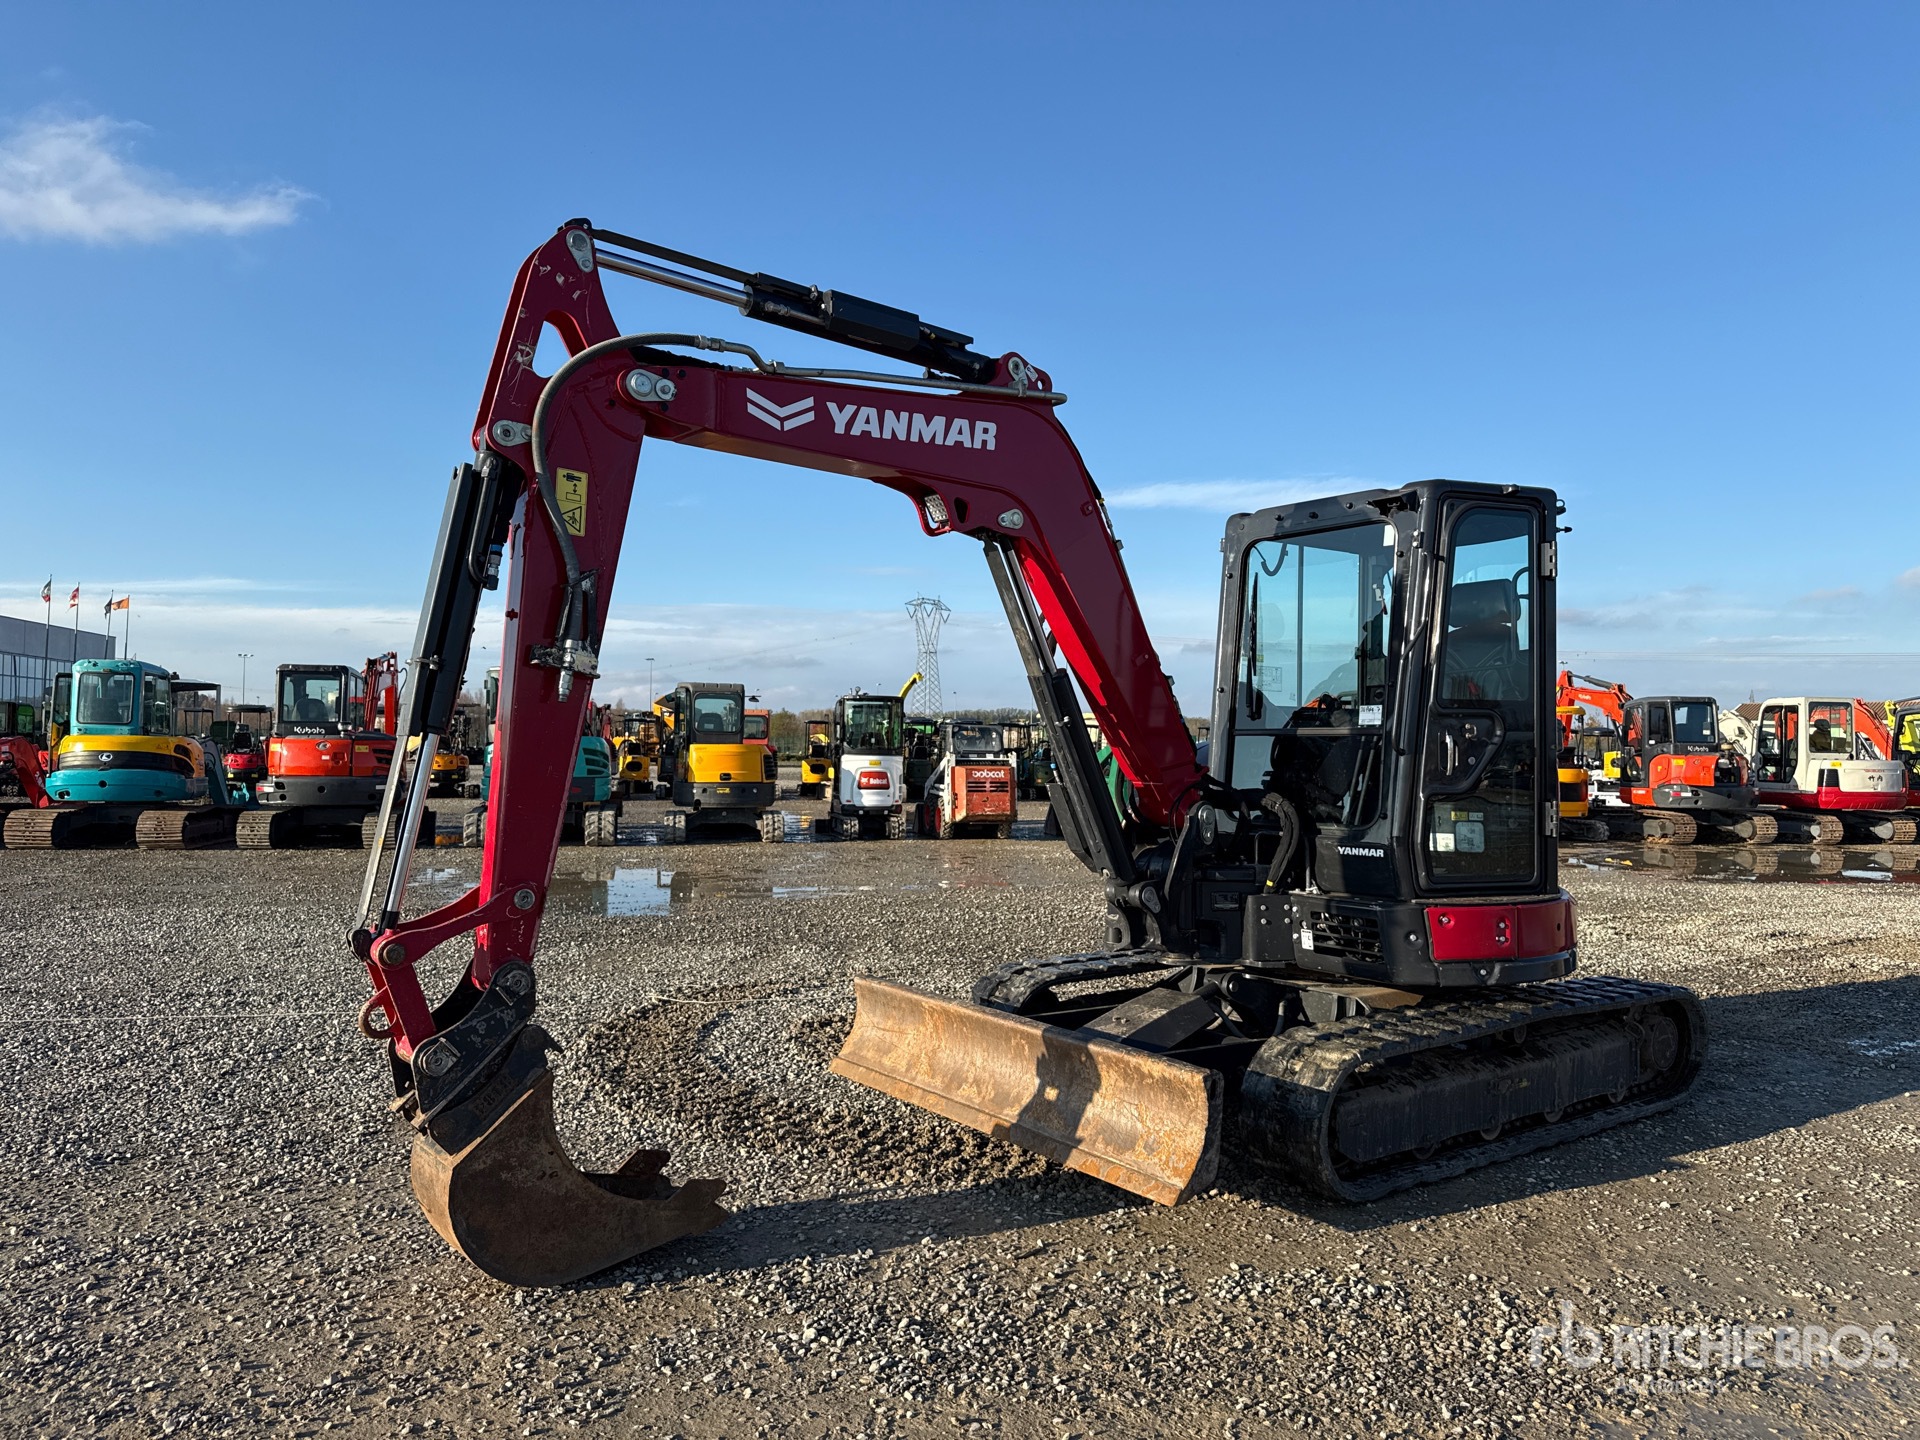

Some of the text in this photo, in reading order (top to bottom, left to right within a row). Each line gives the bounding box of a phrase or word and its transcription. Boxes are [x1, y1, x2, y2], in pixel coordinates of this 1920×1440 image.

[826, 402, 997, 451] YANMAR
[294, 726, 325, 734] Kubota
[972, 769, 1004, 778] bobcat
[1338, 846, 1384, 858] YANMAR
